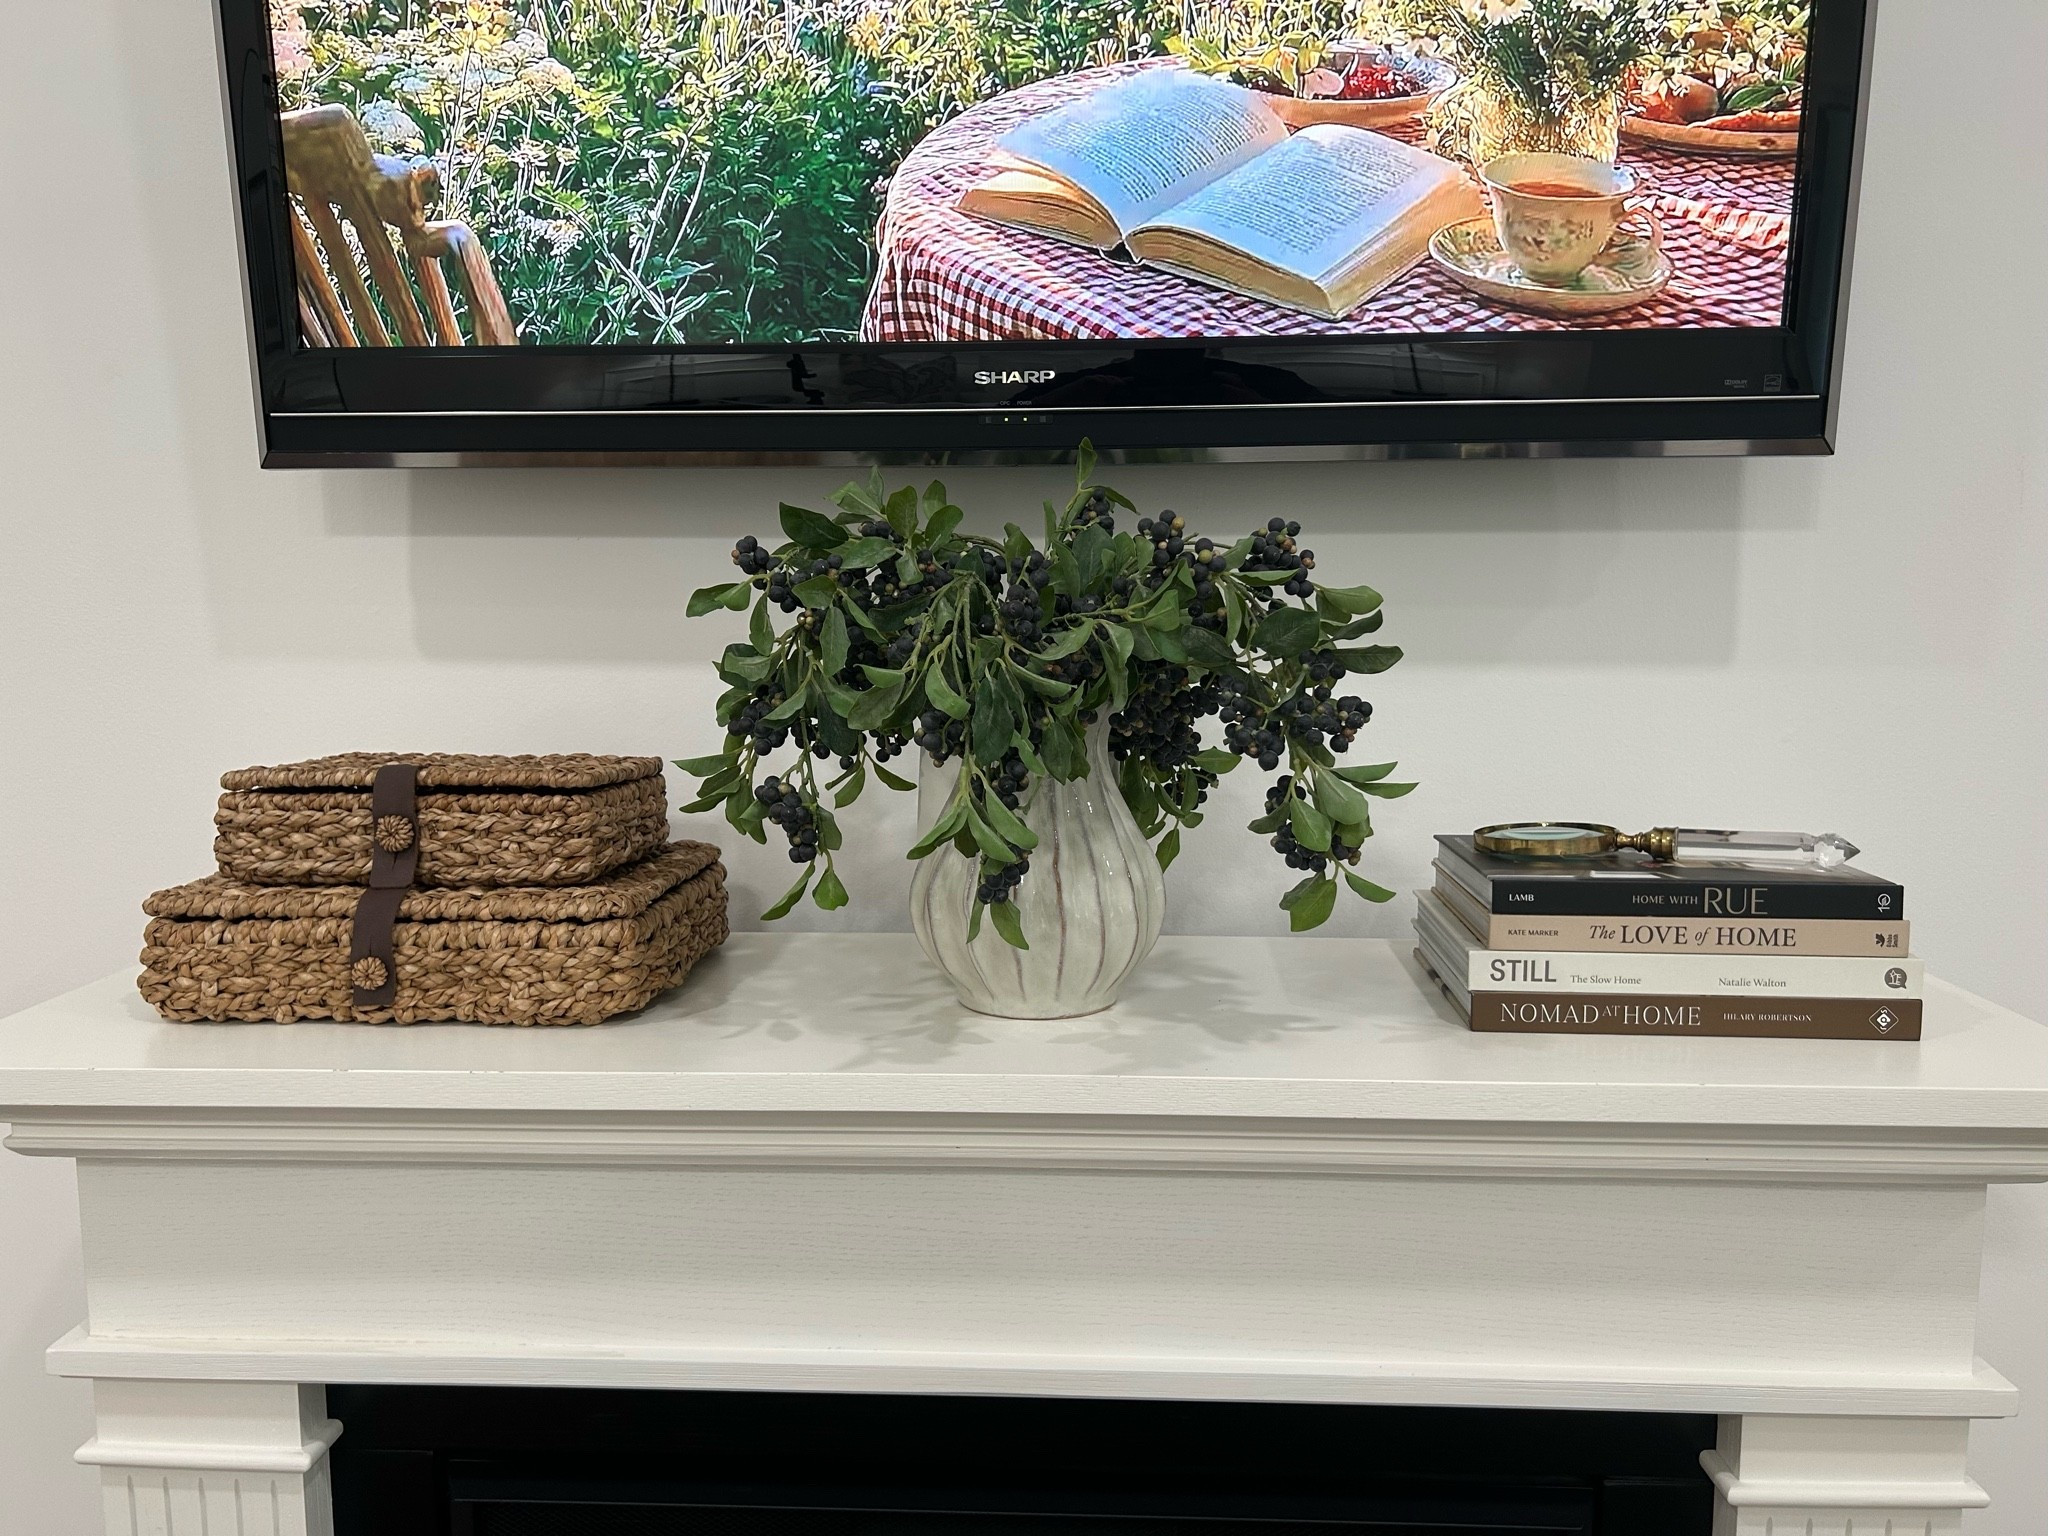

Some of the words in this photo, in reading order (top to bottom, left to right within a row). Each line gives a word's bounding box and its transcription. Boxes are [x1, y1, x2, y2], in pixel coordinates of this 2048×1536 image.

[974, 370, 1056, 385] SHARP
[1508, 893, 1535, 902] LAMB
[1632, 895, 1665, 905] HOME
[1669, 895, 1698, 905] WITH
[1703, 887, 1769, 915] RUE
[1508, 929, 1527, 937] KATE
[1528, 929, 1559, 937] MARKER
[1589, 925, 1616, 940] The
[1620, 925, 1688, 945] LOVE
[1694, 926, 1711, 946] of
[1716, 927, 1797, 947] HOME
[1489, 958, 1557, 983] STILL
[1570, 975, 1588, 984] The
[1590, 975, 1611, 985] Slow
[1613, 975, 1642, 985] Home
[1718, 977, 1751, 987] Natalie
[1752, 977, 1787, 988] Walton
[1500, 1003, 1600, 1024] NOMAD
[1602, 1005, 1620, 1017] AT
[1623, 1005, 1700, 1026] HOME
[1723, 1012, 1756, 1021] HILARY
[1757, 1013, 1812, 1022] ROBERTSON
